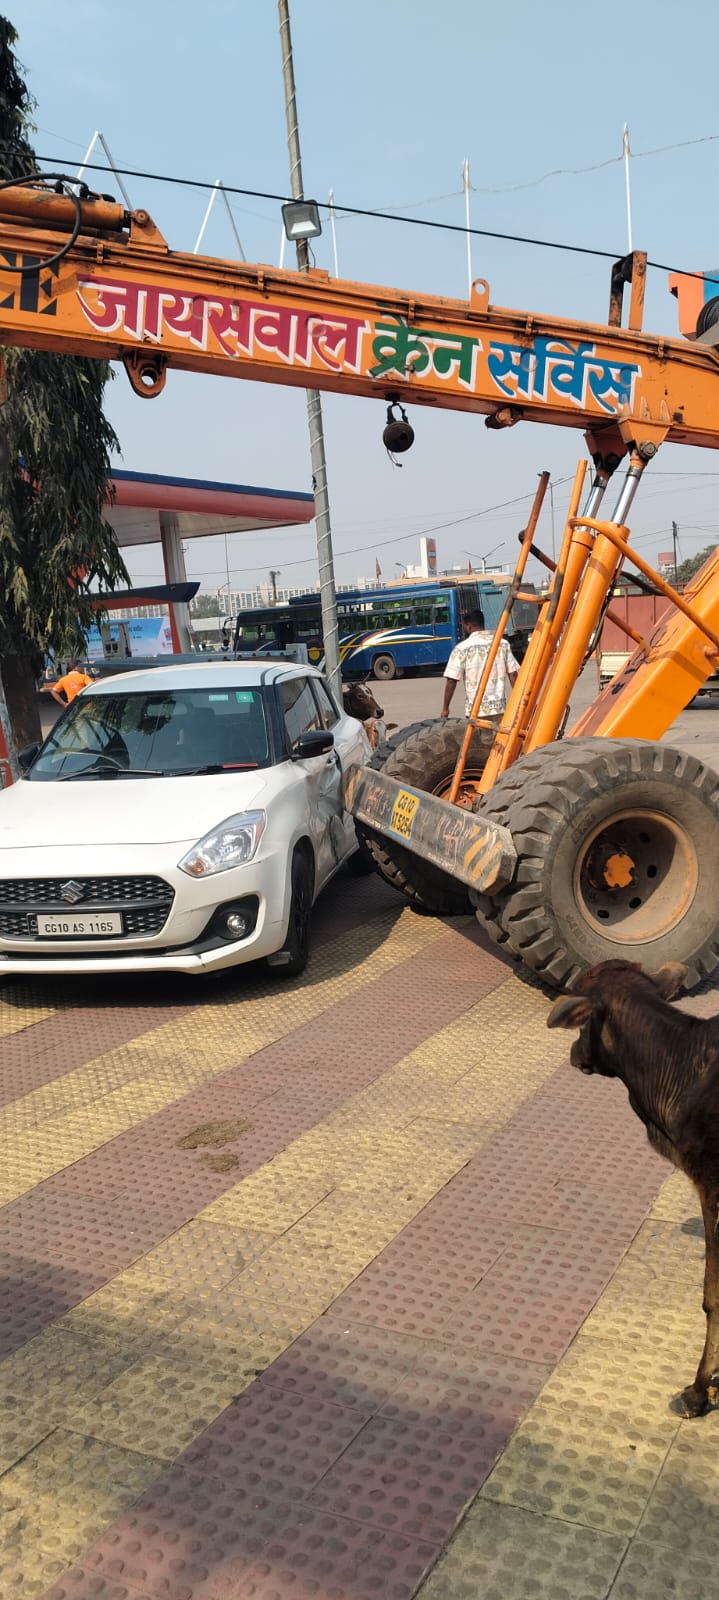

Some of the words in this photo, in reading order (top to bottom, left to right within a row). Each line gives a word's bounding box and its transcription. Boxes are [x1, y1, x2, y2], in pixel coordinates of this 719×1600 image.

[76, 273, 371, 375] जायसवाल
[366, 301, 483, 392] क्रेन
[487, 336, 642, 414] सर्विस
[44, 923, 69, 933] CG10
[73, 923, 85, 932] AS
[89, 922, 113, 932] 1165
